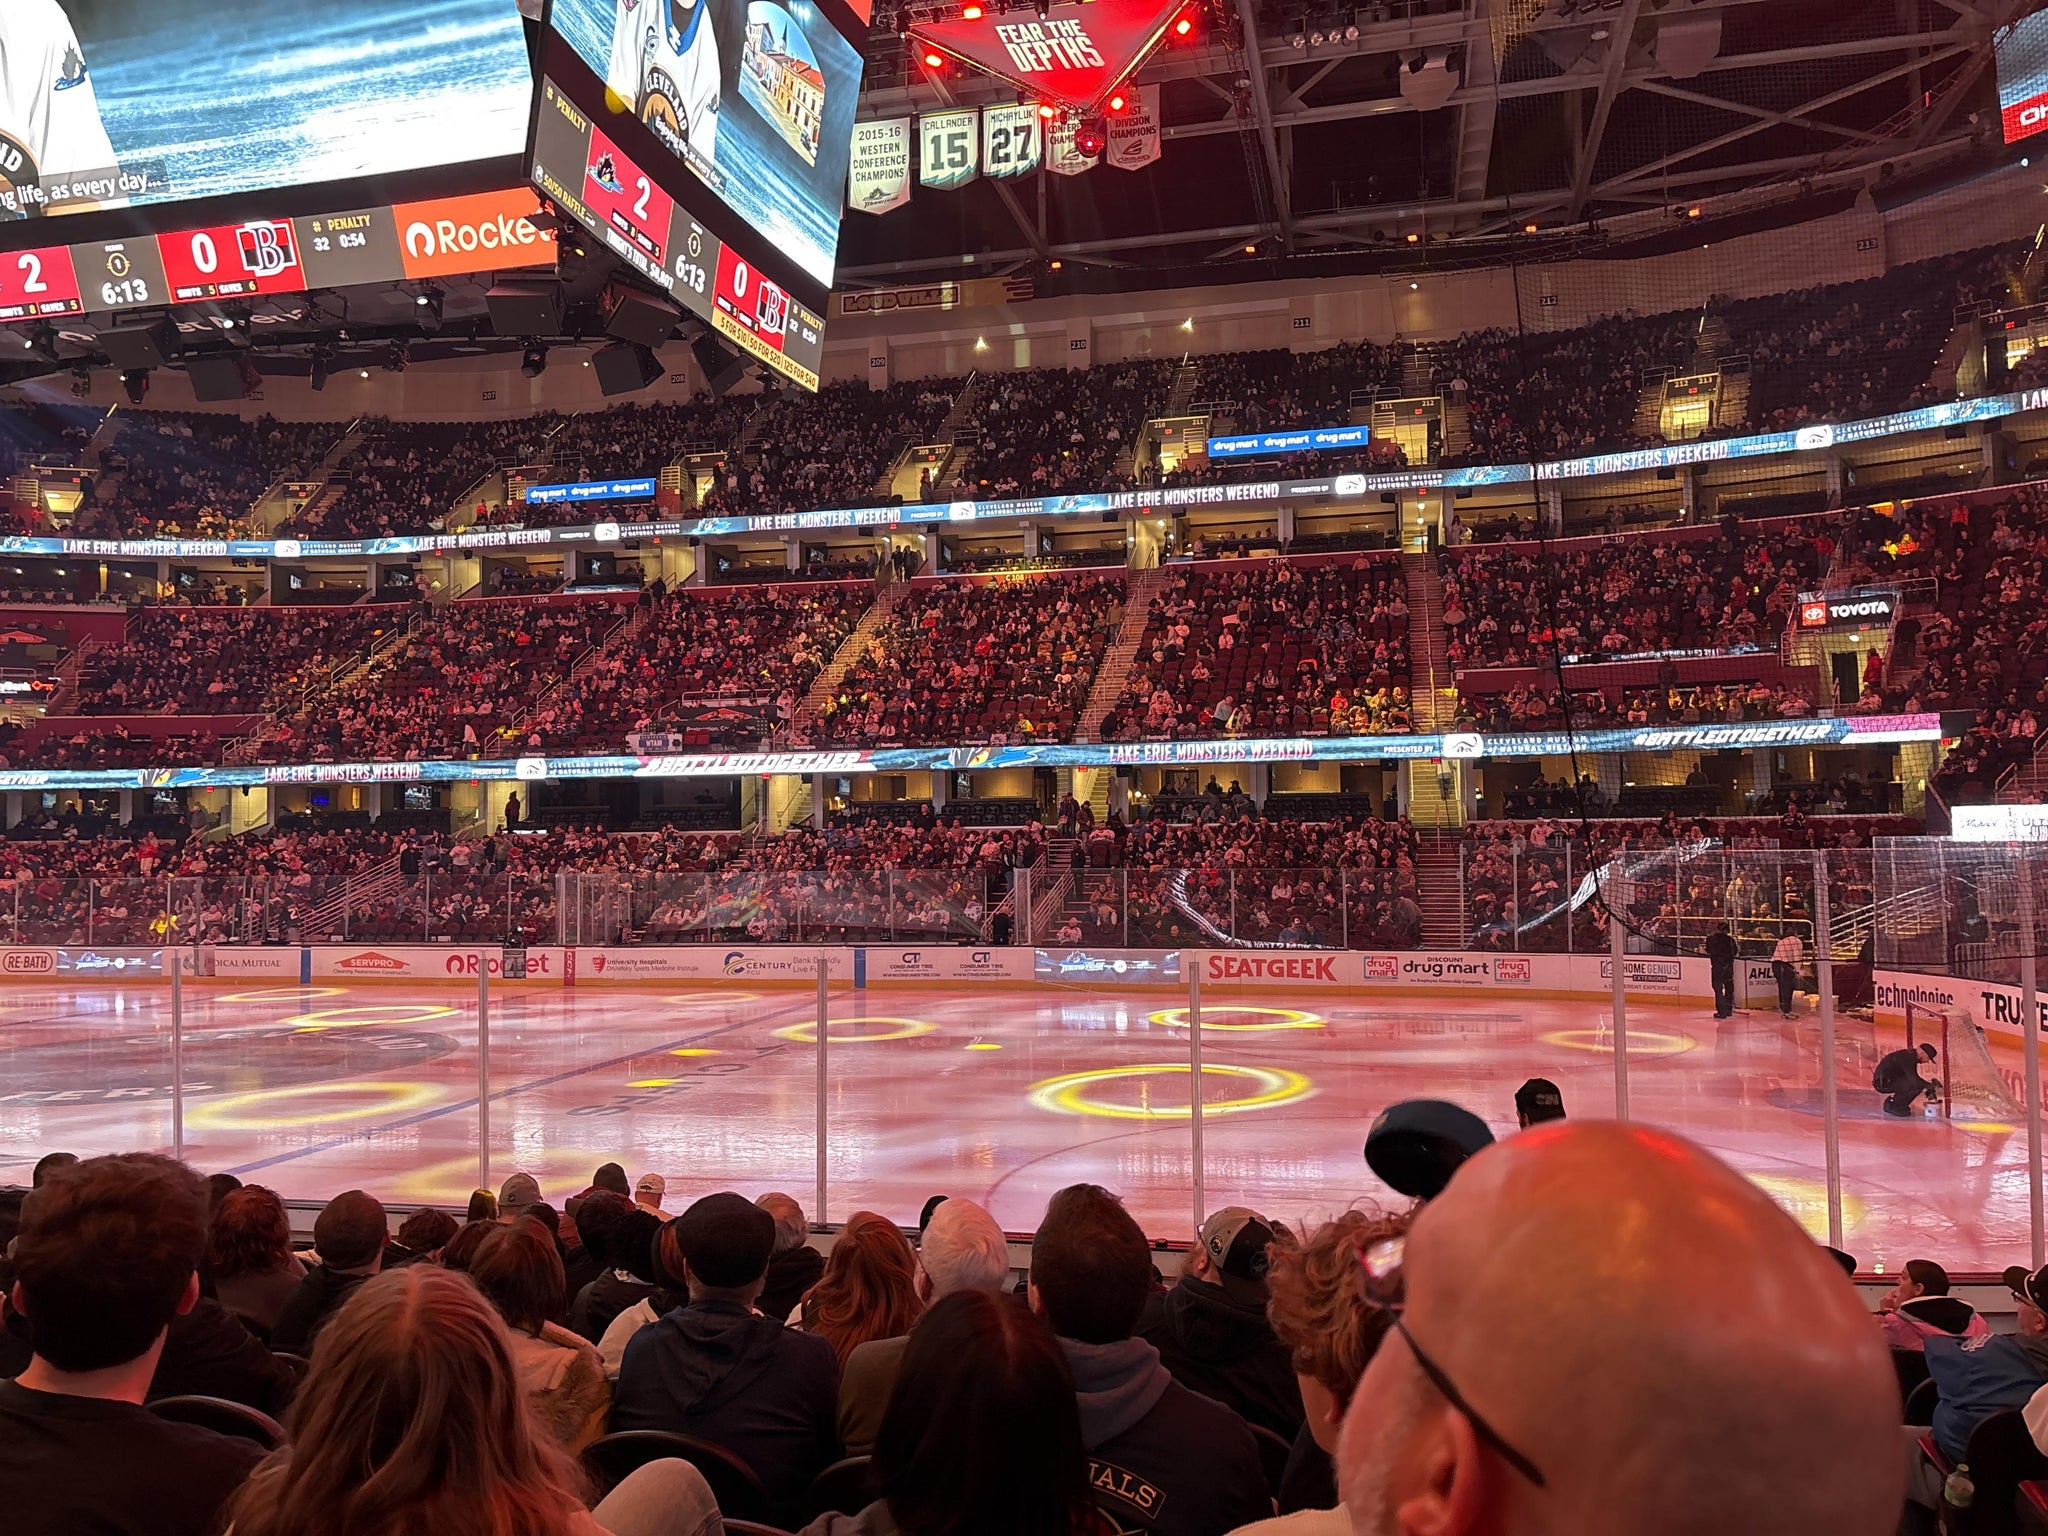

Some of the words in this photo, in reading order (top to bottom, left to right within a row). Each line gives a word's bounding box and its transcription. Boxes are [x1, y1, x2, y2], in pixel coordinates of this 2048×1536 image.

[995, 22, 1046, 44] FEAR
[1043, 18, 1086, 36] THE
[1004, 37, 1105, 72] DEPTHS
[645, 72, 688, 131] CLEVELAND
[556, 95, 587, 133] PENALTY
[989, 109, 1035, 123] MICHAYLUK
[1115, 115, 1151, 128] DIVISION
[924, 116, 974, 131] CALLANDER
[858, 126, 901, 141] 2015-16
[1110, 126, 1157, 140] CHAMPIONS
[859, 142, 900, 156] WESTERN
[929, 131, 970, 171] 15
[991, 124, 1032, 165] 27
[853, 154, 907, 169] CONFERENCE
[855, 168, 905, 182] CHAMPIONS
[17, 184, 49, 204] life,
[52, 184, 69, 199] as
[72, 177, 116, 197] every
[119, 172, 162, 193] day...
[543, 173, 562, 199] 50/50
[561, 192, 587, 220] RAFFLE
[633, 176, 651, 222] 2
[313, 221, 322, 232] #
[327, 215, 371, 231] PENALTY
[313, 237, 331, 252] 32
[340, 232, 367, 249] 0:54
[1857, 239, 1878, 250] 213
[190, 232, 218, 274] 0
[17, 252, 48, 293] 2
[675, 254, 706, 294] 6:13
[733, 261, 748, 298] 0
[101, 279, 149, 305] 6:13
[208, 285, 216, 296] 5
[248, 280, 256, 291] 6
[29, 304, 37, 315] 8
[70, 300, 78, 311] 5
[1540, 296, 1557, 306] 212
[789, 319, 798, 333] 32
[1294, 318, 1310, 327] 211
[720, 317, 726, 328] 5
[725, 320, 737, 337] FOR
[736, 327, 747, 344] $10
[749, 338, 758, 352] 50
[758, 342, 770, 360] FOR
[769, 348, 781, 365] $20
[784, 356, 794, 373] 125
[793, 364, 805, 381] FOR
[805, 371, 816, 388] $40
[1071, 341, 1087, 350] 210
[871, 358, 885, 367] 209
[483, 391, 496, 400] 207
[1213, 442, 1235, 451] drug
[1235, 439, 1259, 449] mart
[1264, 437, 1287, 448] drug
[1287, 435, 1310, 445] mart
[1315, 433, 1338, 444] drug
[1338, 431, 1362, 441] mart
[1530, 463, 1559, 481] LAKE
[1563, 460, 1590, 478] ERIE
[1594, 451, 1662, 474] MONSTERS
[1667, 442, 1728, 465] WEEKEND
[1107, 494, 1134, 510] LAKE
[1137, 492, 1161, 508] ERIE
[1164, 488, 1223, 506] MONSTERS
[1226, 483, 1280, 501] WEEKEND
[749, 516, 773, 531] LAKE
[775, 515, 797, 530] ERIE
[798, 512, 852, 528] MONSTERS
[854, 509, 901, 525] WEEKEND
[63, 540, 91, 554] LAKE
[94, 541, 119, 555] ERIE
[121, 541, 178, 556] MONSTERS
[180, 541, 228, 557] WEEKEND
[413, 536, 435, 551] LAKE
[437, 535, 457, 549] ERIE
[459, 532, 507, 548] MONSTERS
[508, 529, 552, 545] WEEKEND
[1829, 601, 1890, 619] TOYOTA
[1109, 745, 1140, 762] LAKE
[1144, 744, 1172, 761] ERIE
[1176, 742, 1246, 760] MONSTERS
[1250, 740, 1313, 760] WEEKEND
[1383, 746, 1423, 754] PRESENTED
[1423, 745, 1434, 753] BY
[264, 766, 289, 782] LAKE
[291, 766, 314, 782] ERIE
[316, 764, 370, 781] MONSTERS
[372, 763, 420, 779] WEEKEND
[7, 955, 48, 969] RE-BATH
[351, 958, 394, 968] SERVPRO
[467, 953, 549, 975] Roet
[607, 959, 637, 967] University
[639, 959, 668, 967] Hospitals
[746, 962, 792, 970] CENTURY
[1208, 955, 1338, 982] SEATGEEK
[1366, 956, 1392, 969] drug
[1403, 960, 1444, 977] drug
[1447, 962, 1490, 975] mart
[1497, 959, 1524, 971] drug
[1368, 968, 1397, 977] mart
[1499, 970, 1530, 979] mart
[1981, 991, 2048, 1032] TRUE
